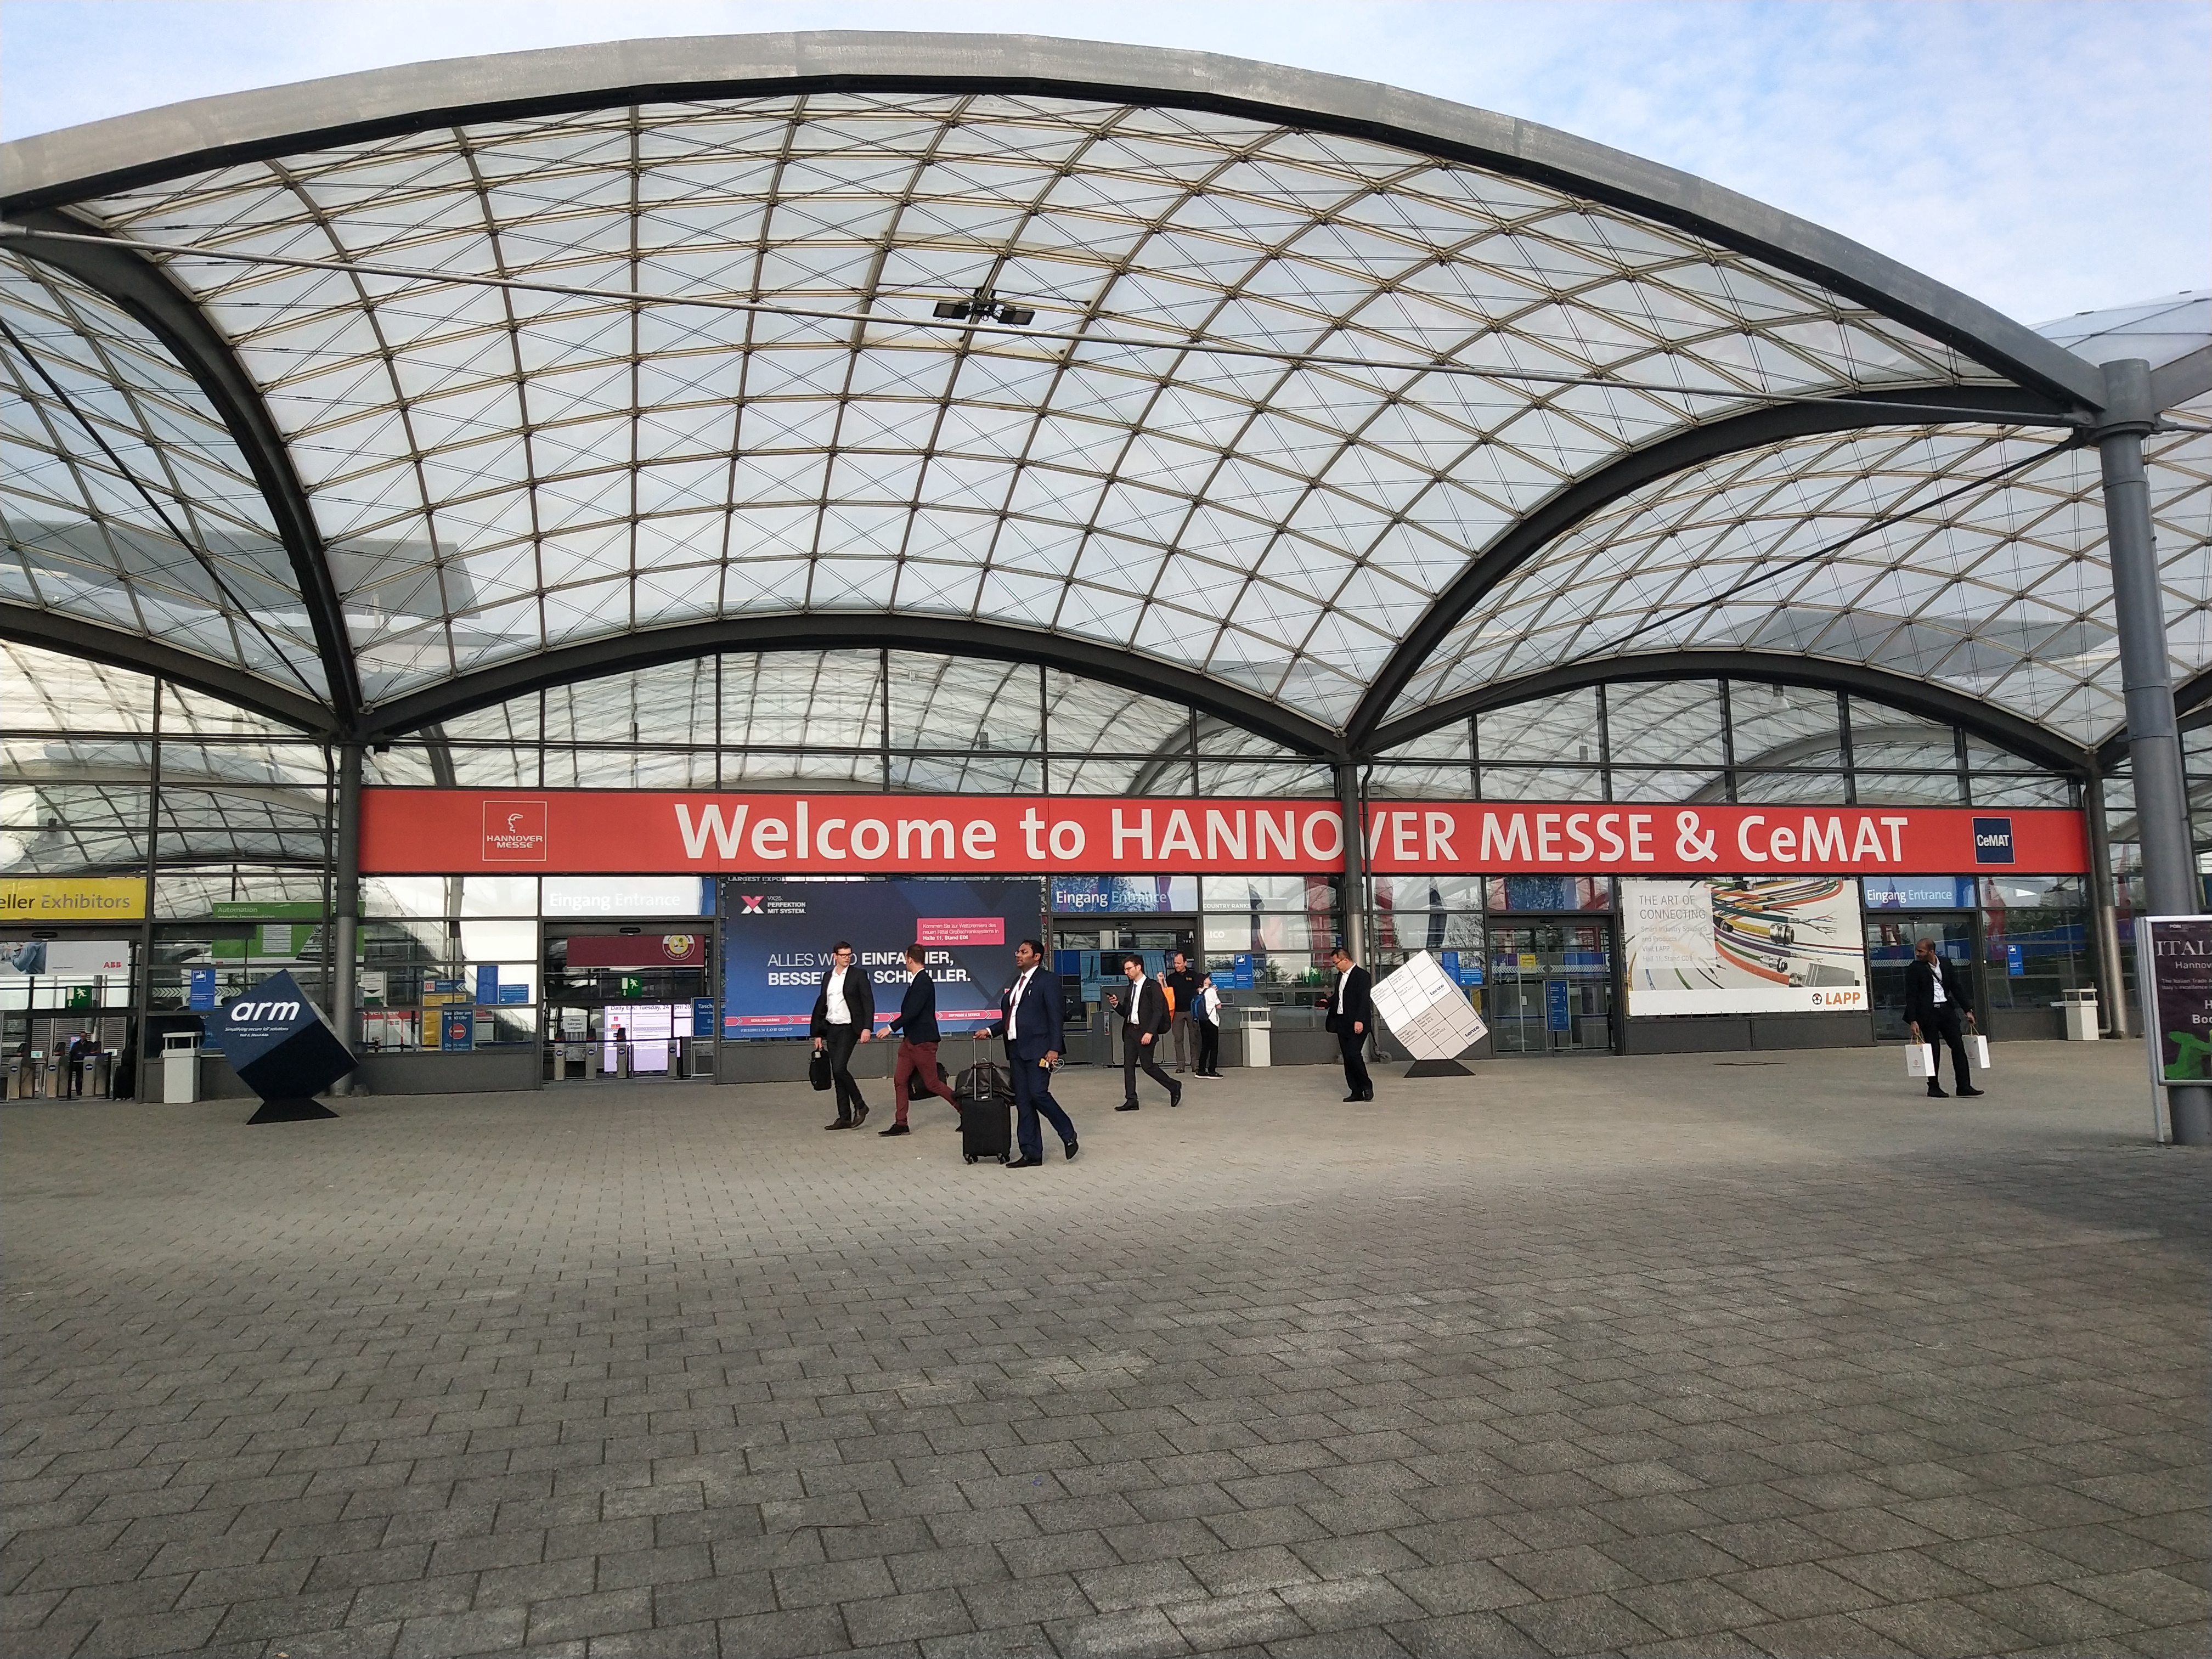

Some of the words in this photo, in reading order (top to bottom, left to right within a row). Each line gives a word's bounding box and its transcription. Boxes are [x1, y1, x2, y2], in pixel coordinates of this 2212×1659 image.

[674, 801, 997, 860] Welcome
[1019, 806, 1086, 860] to
[1111, 808, 1459, 861] HANNOVER
[1480, 812, 1655, 862] MESSE
[1675, 810, 1718, 862] &
[1738, 815, 1908, 862] CeMAT
[1976, 834, 2009, 847] CeMAT
[41, 894, 131, 909] Exhibitors
[550, 893, 610, 910] Eingang
[615, 894, 680, 906] Entrance
[1056, 890, 1108, 907] Eingang
[1111, 891, 1167, 904] Entrance
[1639, 895, 1658, 905] THE
[1661, 895, 1679, 905] ART
[1682, 895, 1695, 905] OF
[1867, 889, 1906, 904] Eingang
[1909, 890, 1952, 900] Entrance
[1640, 909, 1706, 919] CONNECTING
[1659, 926, 1680, 934] Industry
[768, 953, 814, 967] ALLES
[768, 971, 825, 986] BESSE
[1430, 984, 1444, 996] Lenze
[1826, 992, 1860, 1005] LAPP
[231, 1001, 300, 1022] arm
[1464, 1025, 1480, 1037] Lenze
